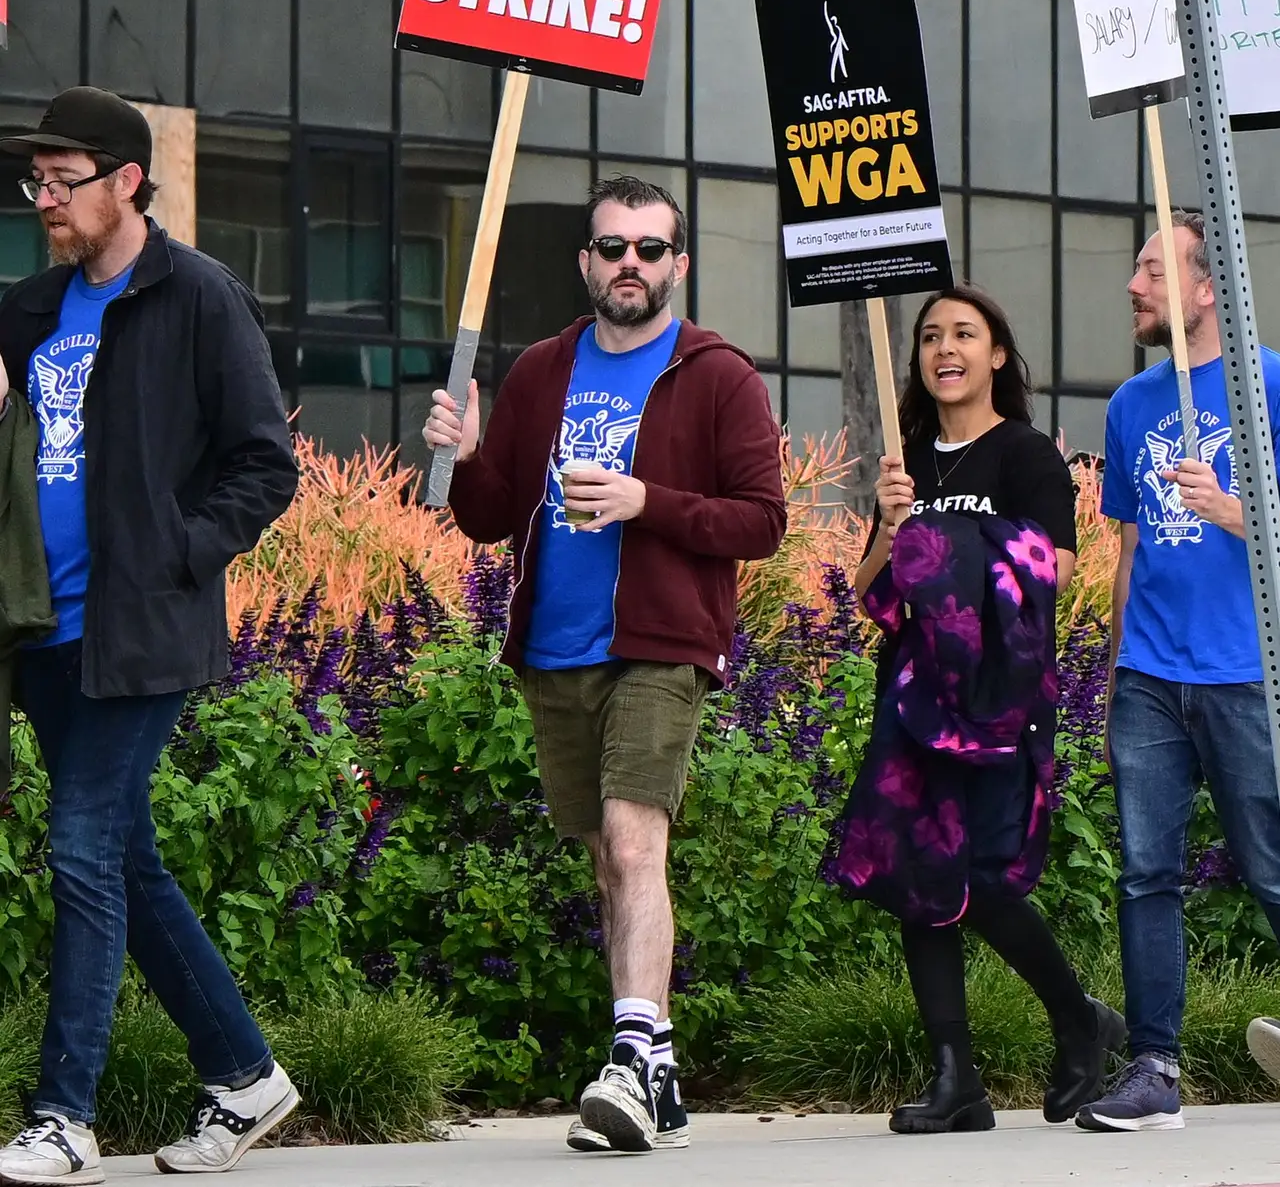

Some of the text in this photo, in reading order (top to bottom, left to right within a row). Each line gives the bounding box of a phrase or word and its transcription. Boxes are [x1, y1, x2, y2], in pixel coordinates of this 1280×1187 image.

[785, 109, 918, 150] SUPPORTS
[788, 143, 926, 208] WGA
[796, 234, 823, 245] Acting
[824, 230, 858, 243] Together
[860, 228, 871, 238] for
[879, 225, 904, 236] Better
[905, 221, 932, 232] Future
[49, 333, 96, 356] GUILD
[564, 392, 632, 412] GUILD OF
[1200, 411, 1220, 427] OF
[1165, 528, 1189, 536] WEST
